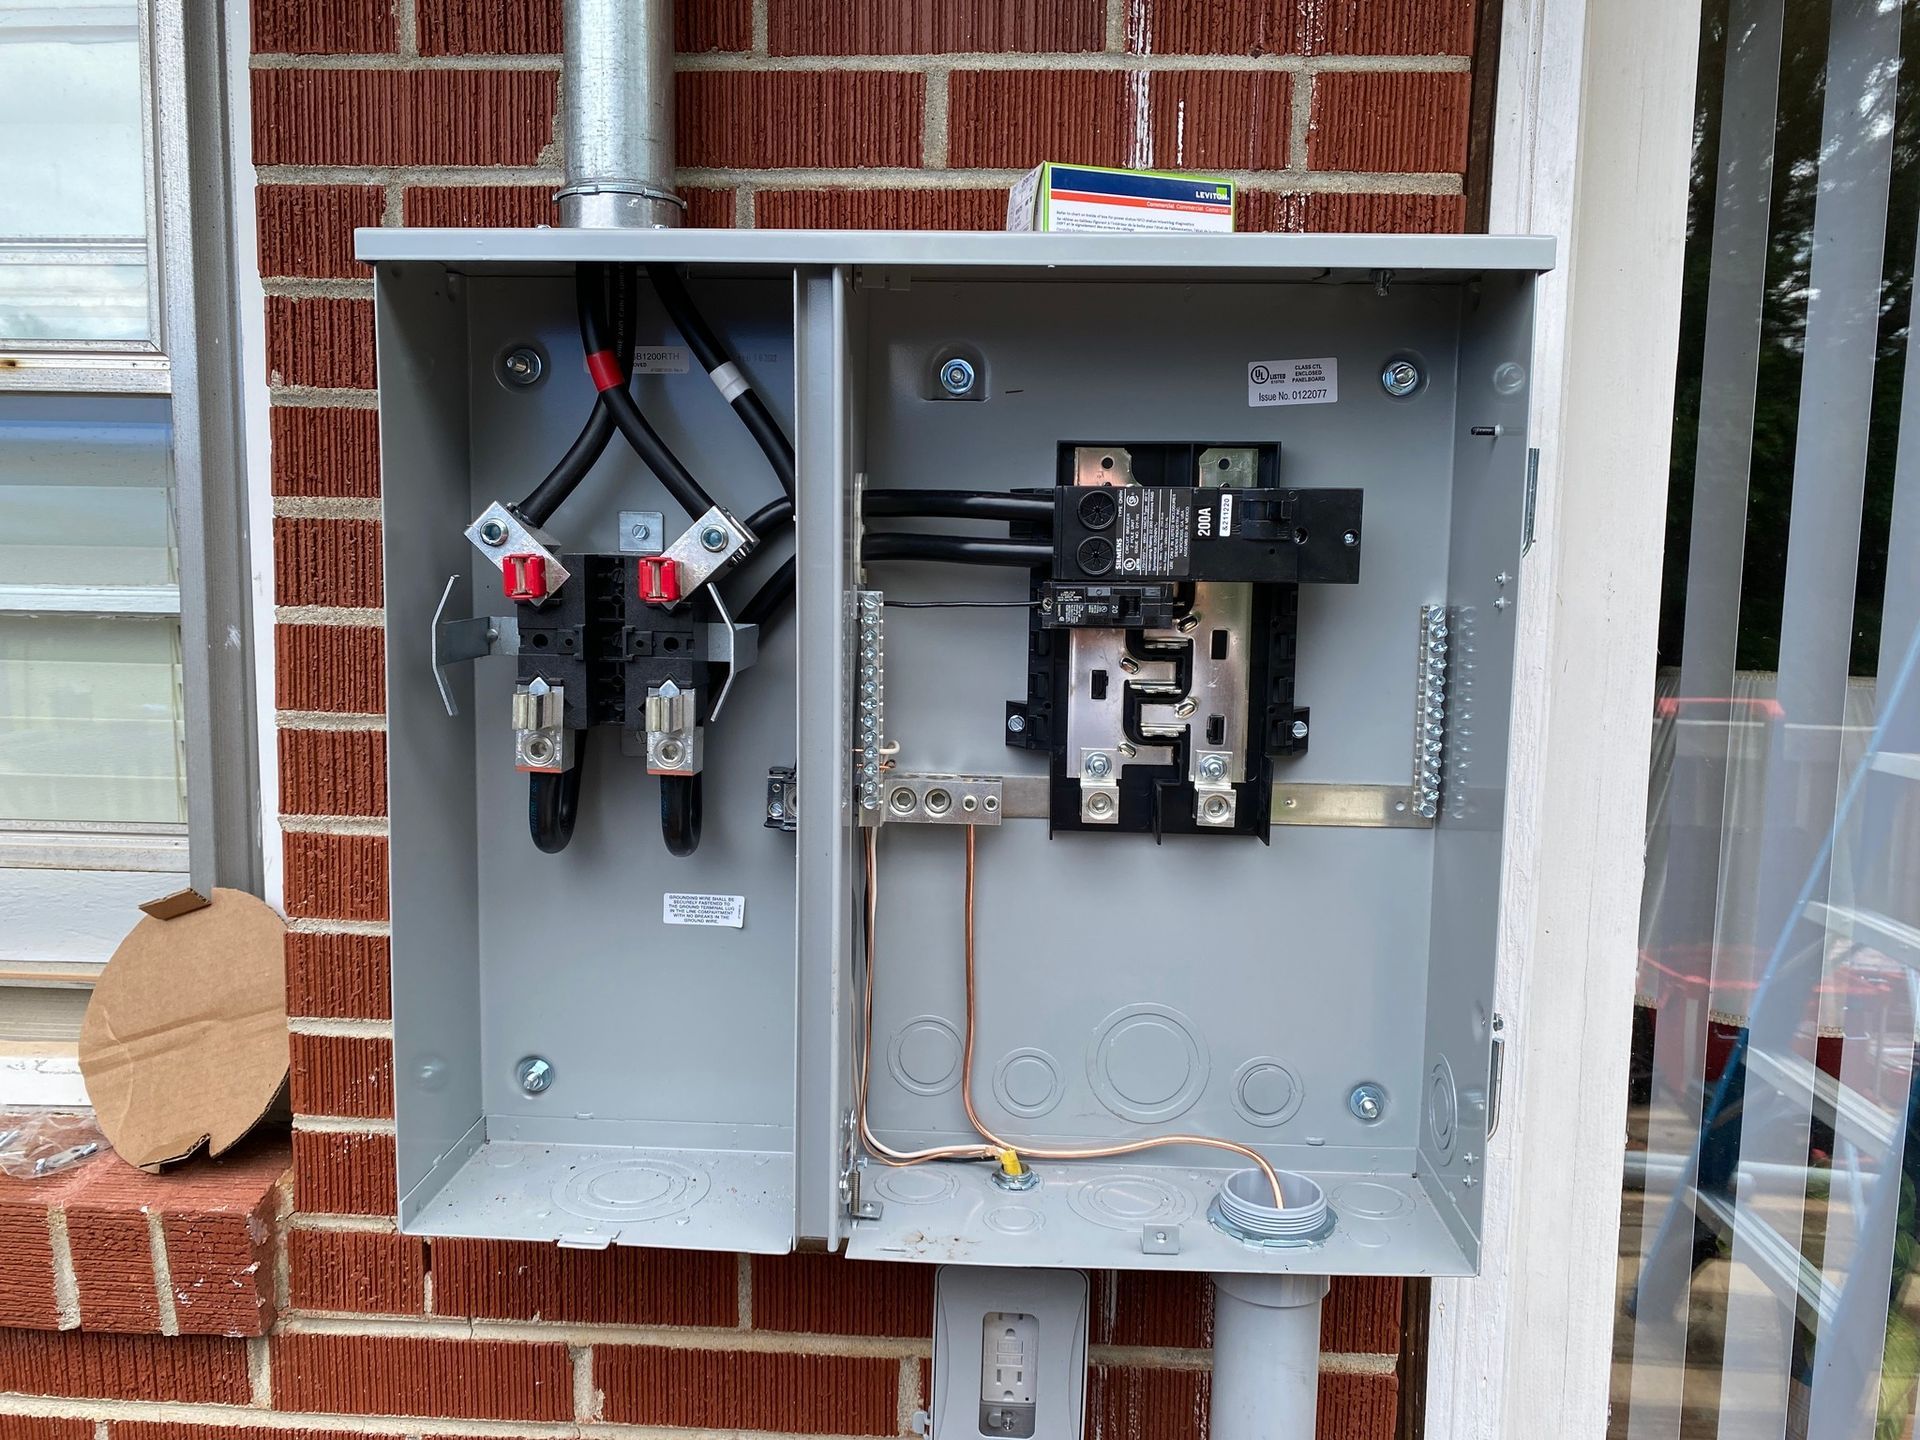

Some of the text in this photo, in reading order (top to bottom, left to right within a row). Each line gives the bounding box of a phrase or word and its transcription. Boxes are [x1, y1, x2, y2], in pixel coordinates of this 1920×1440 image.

[1196, 191, 1227, 200] LEVITON
[634, 352, 680, 361] B1200RTH
[1259, 389, 1327, 401] Issue No. 0122077
[1221, 498, 1229, 530] &211220
[1198, 508, 1211, 536] 200A
[1112, 605, 1119, 614] 20
